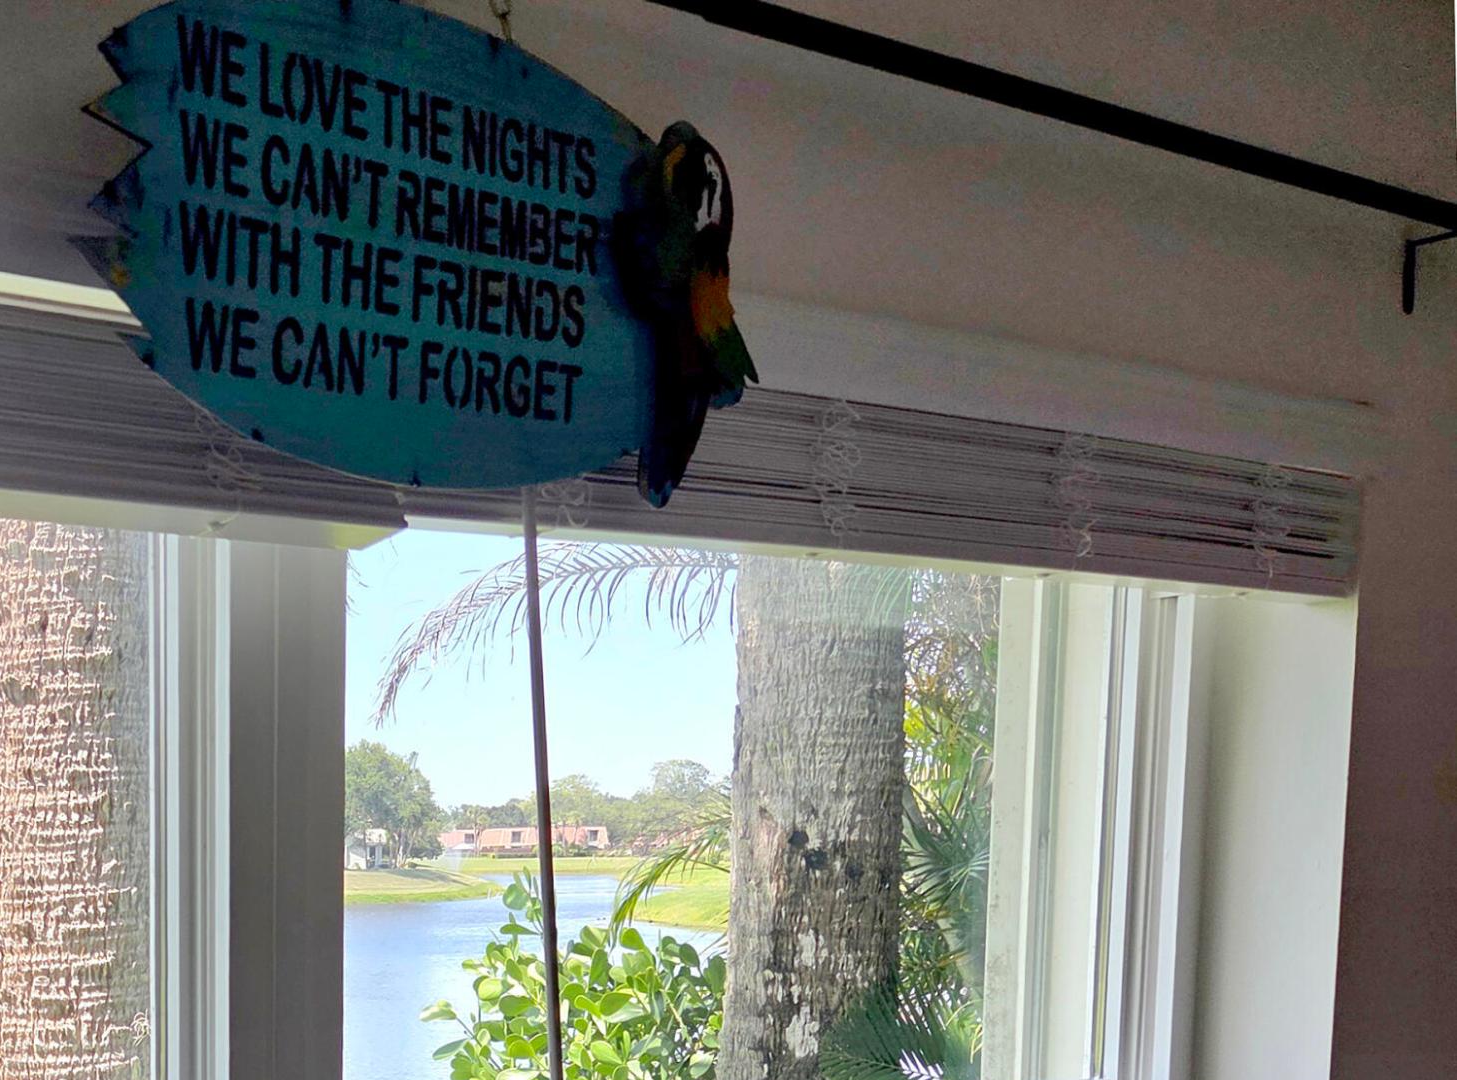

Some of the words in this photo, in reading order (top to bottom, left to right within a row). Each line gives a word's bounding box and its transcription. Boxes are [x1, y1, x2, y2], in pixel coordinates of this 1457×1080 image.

[177, 17, 248, 106] WE
[259, 42, 369, 139] LOVE
[374, 79, 453, 165] THE
[462, 107, 596, 199] NIGHTS
[179, 109, 250, 198] WE
[260, 136, 390, 229] CAN'T
[396, 170, 599, 276] REMEMBER
[180, 205, 301, 298] WITH
[314, 232, 403, 315] THE
[412, 262, 586, 348] FRIENDS
[186, 299, 259, 378] WE
[272, 317, 409, 400] CAN'T
[419, 342, 583, 423] FORGET
